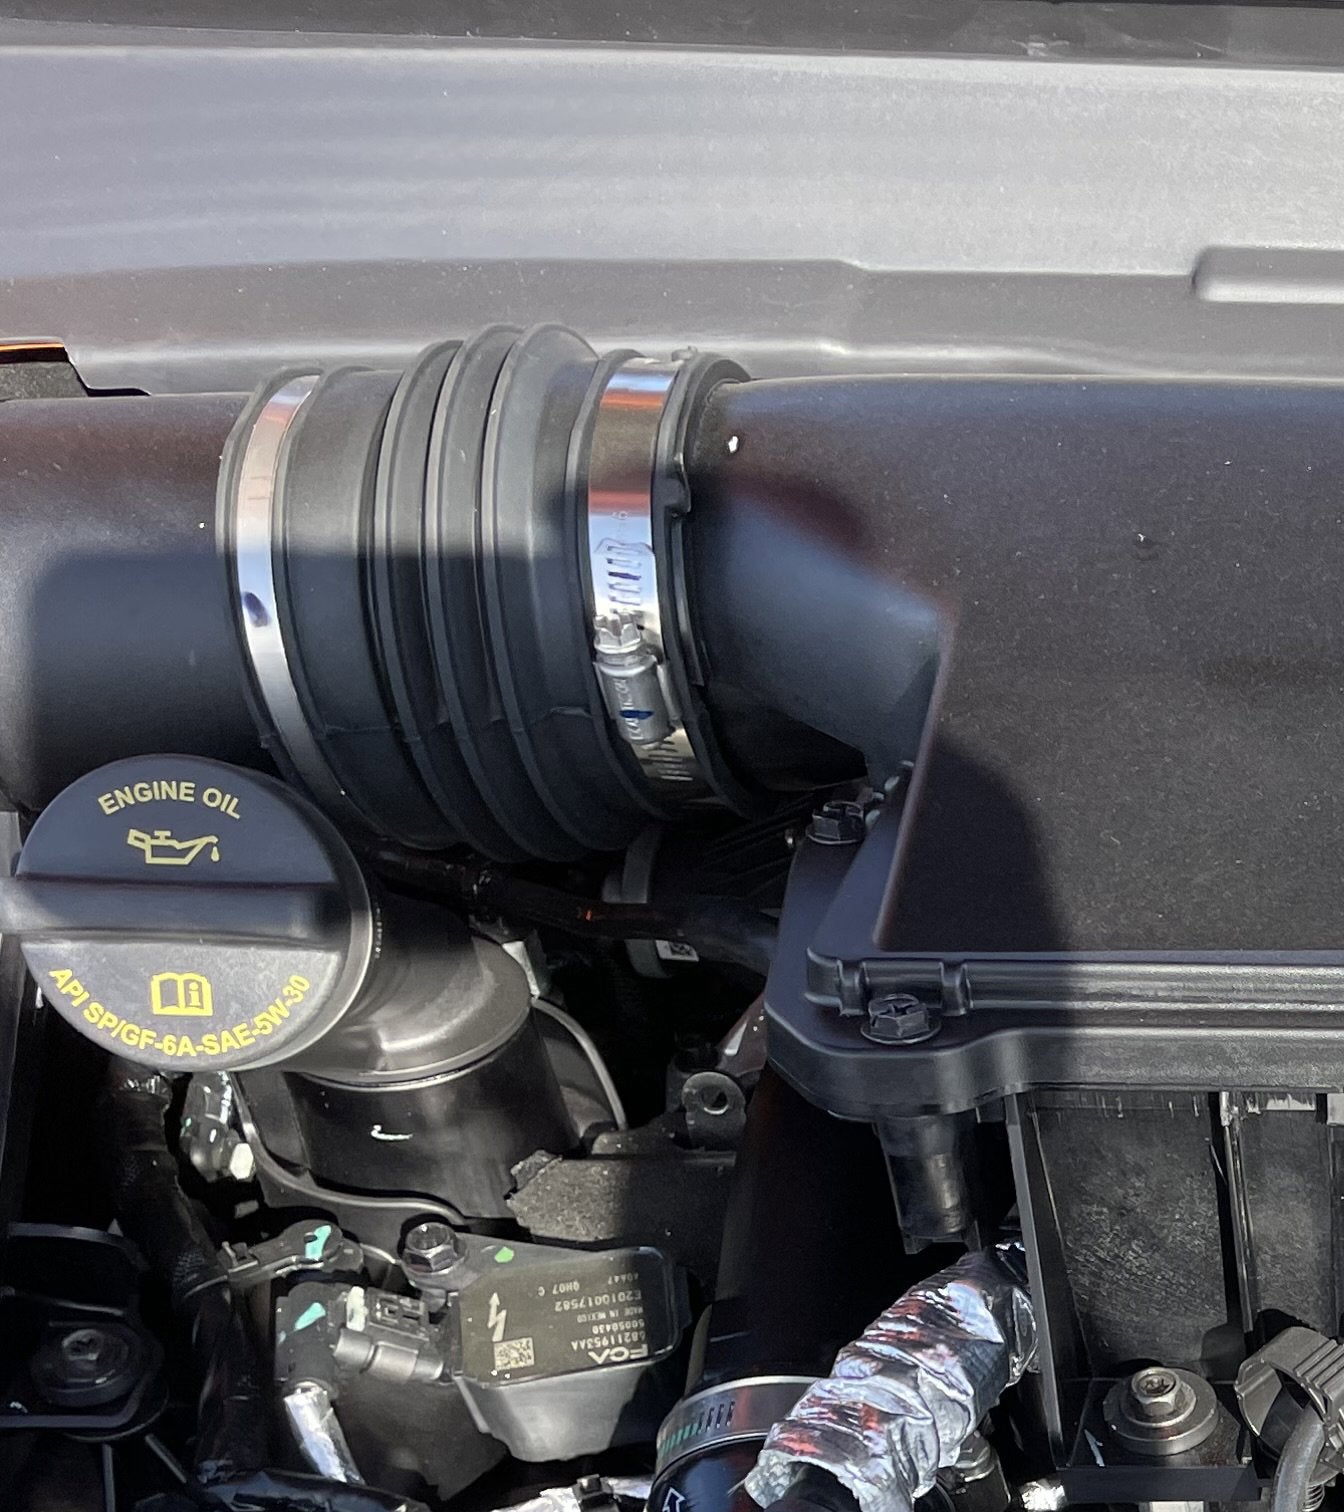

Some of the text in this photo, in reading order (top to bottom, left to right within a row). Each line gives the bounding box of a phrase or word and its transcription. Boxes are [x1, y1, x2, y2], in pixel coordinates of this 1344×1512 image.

[98, 781, 241, 818] ENGINE OIL
[49, 968, 310, 1056] API SP/GF-6A-SAE-5W-30
[588, 1344, 648, 1364] FCA
